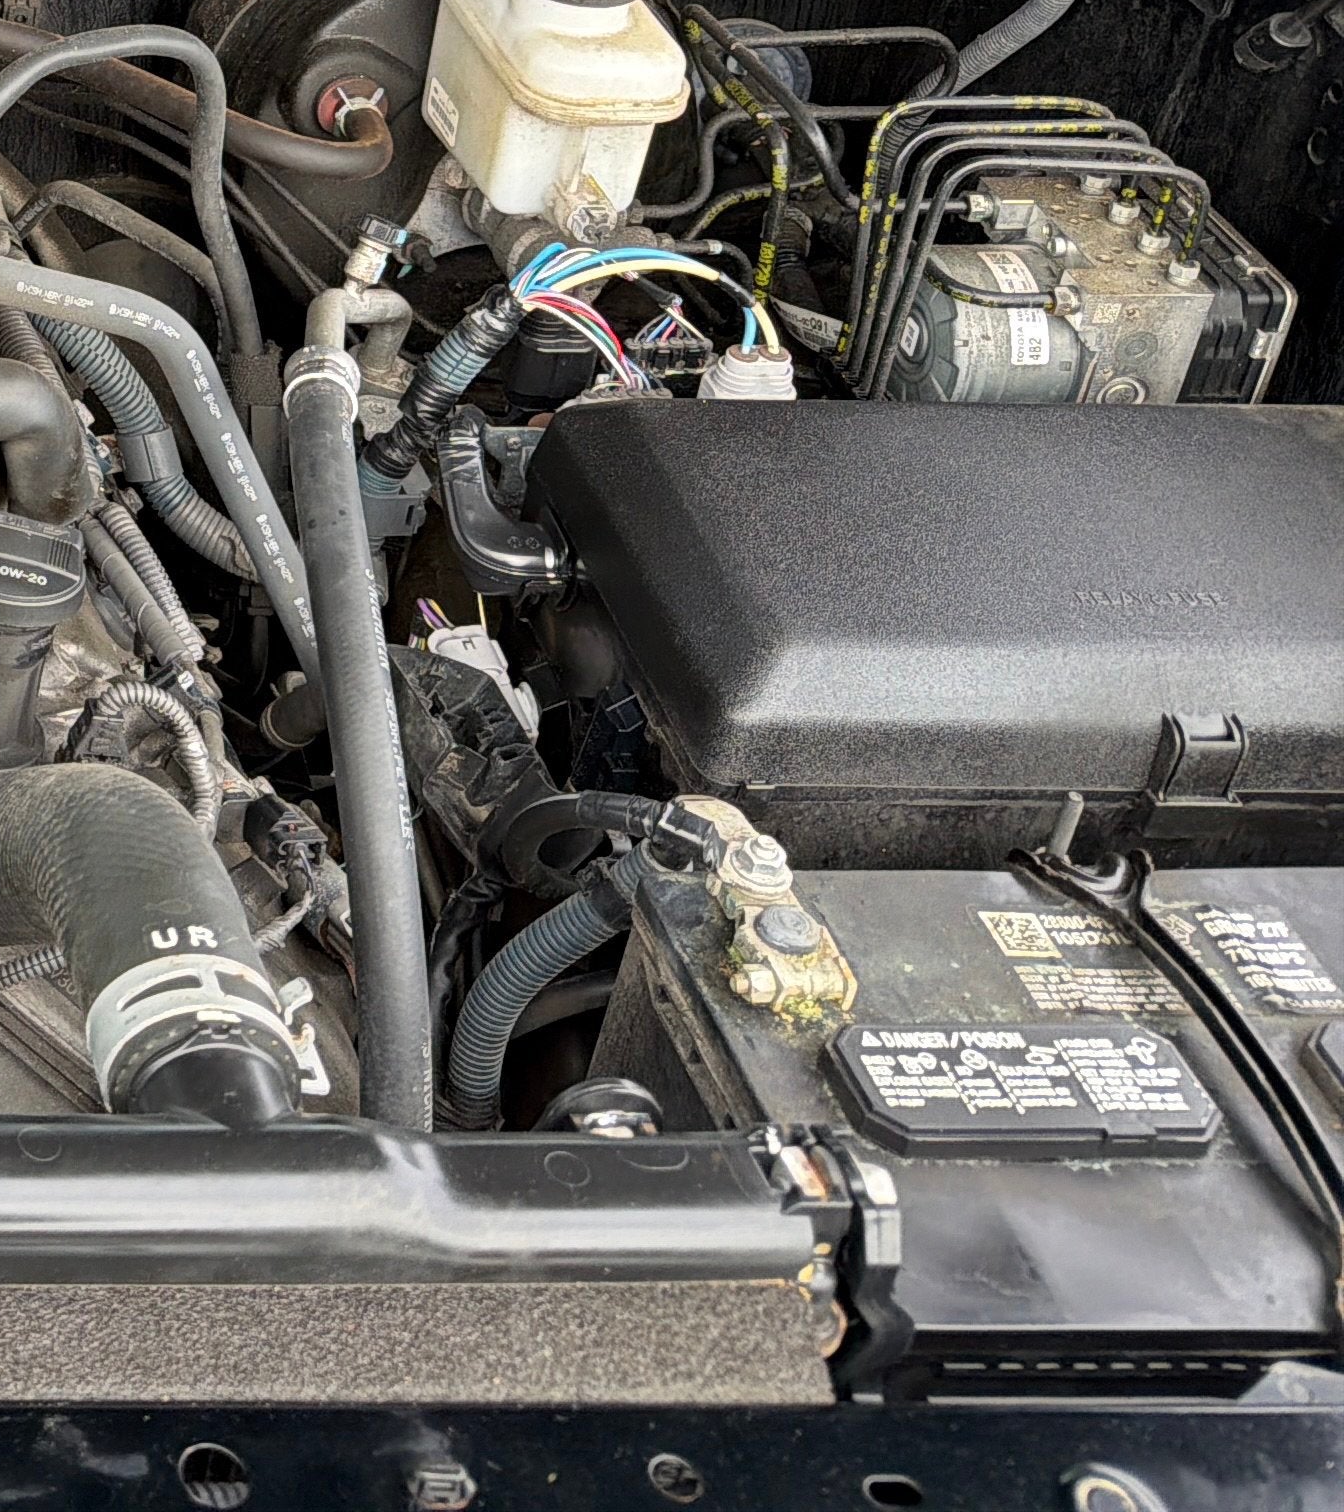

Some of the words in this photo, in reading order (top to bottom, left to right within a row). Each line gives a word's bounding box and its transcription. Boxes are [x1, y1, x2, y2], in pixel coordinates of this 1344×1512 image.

[1029, 338, 1041, 360] 482
[0, 565, 47, 585] 0W-20
[1074, 591, 1143, 607] RELAY
[879, 1031, 949, 1048] DANGER
[959, 1031, 1026, 1048] POISON
